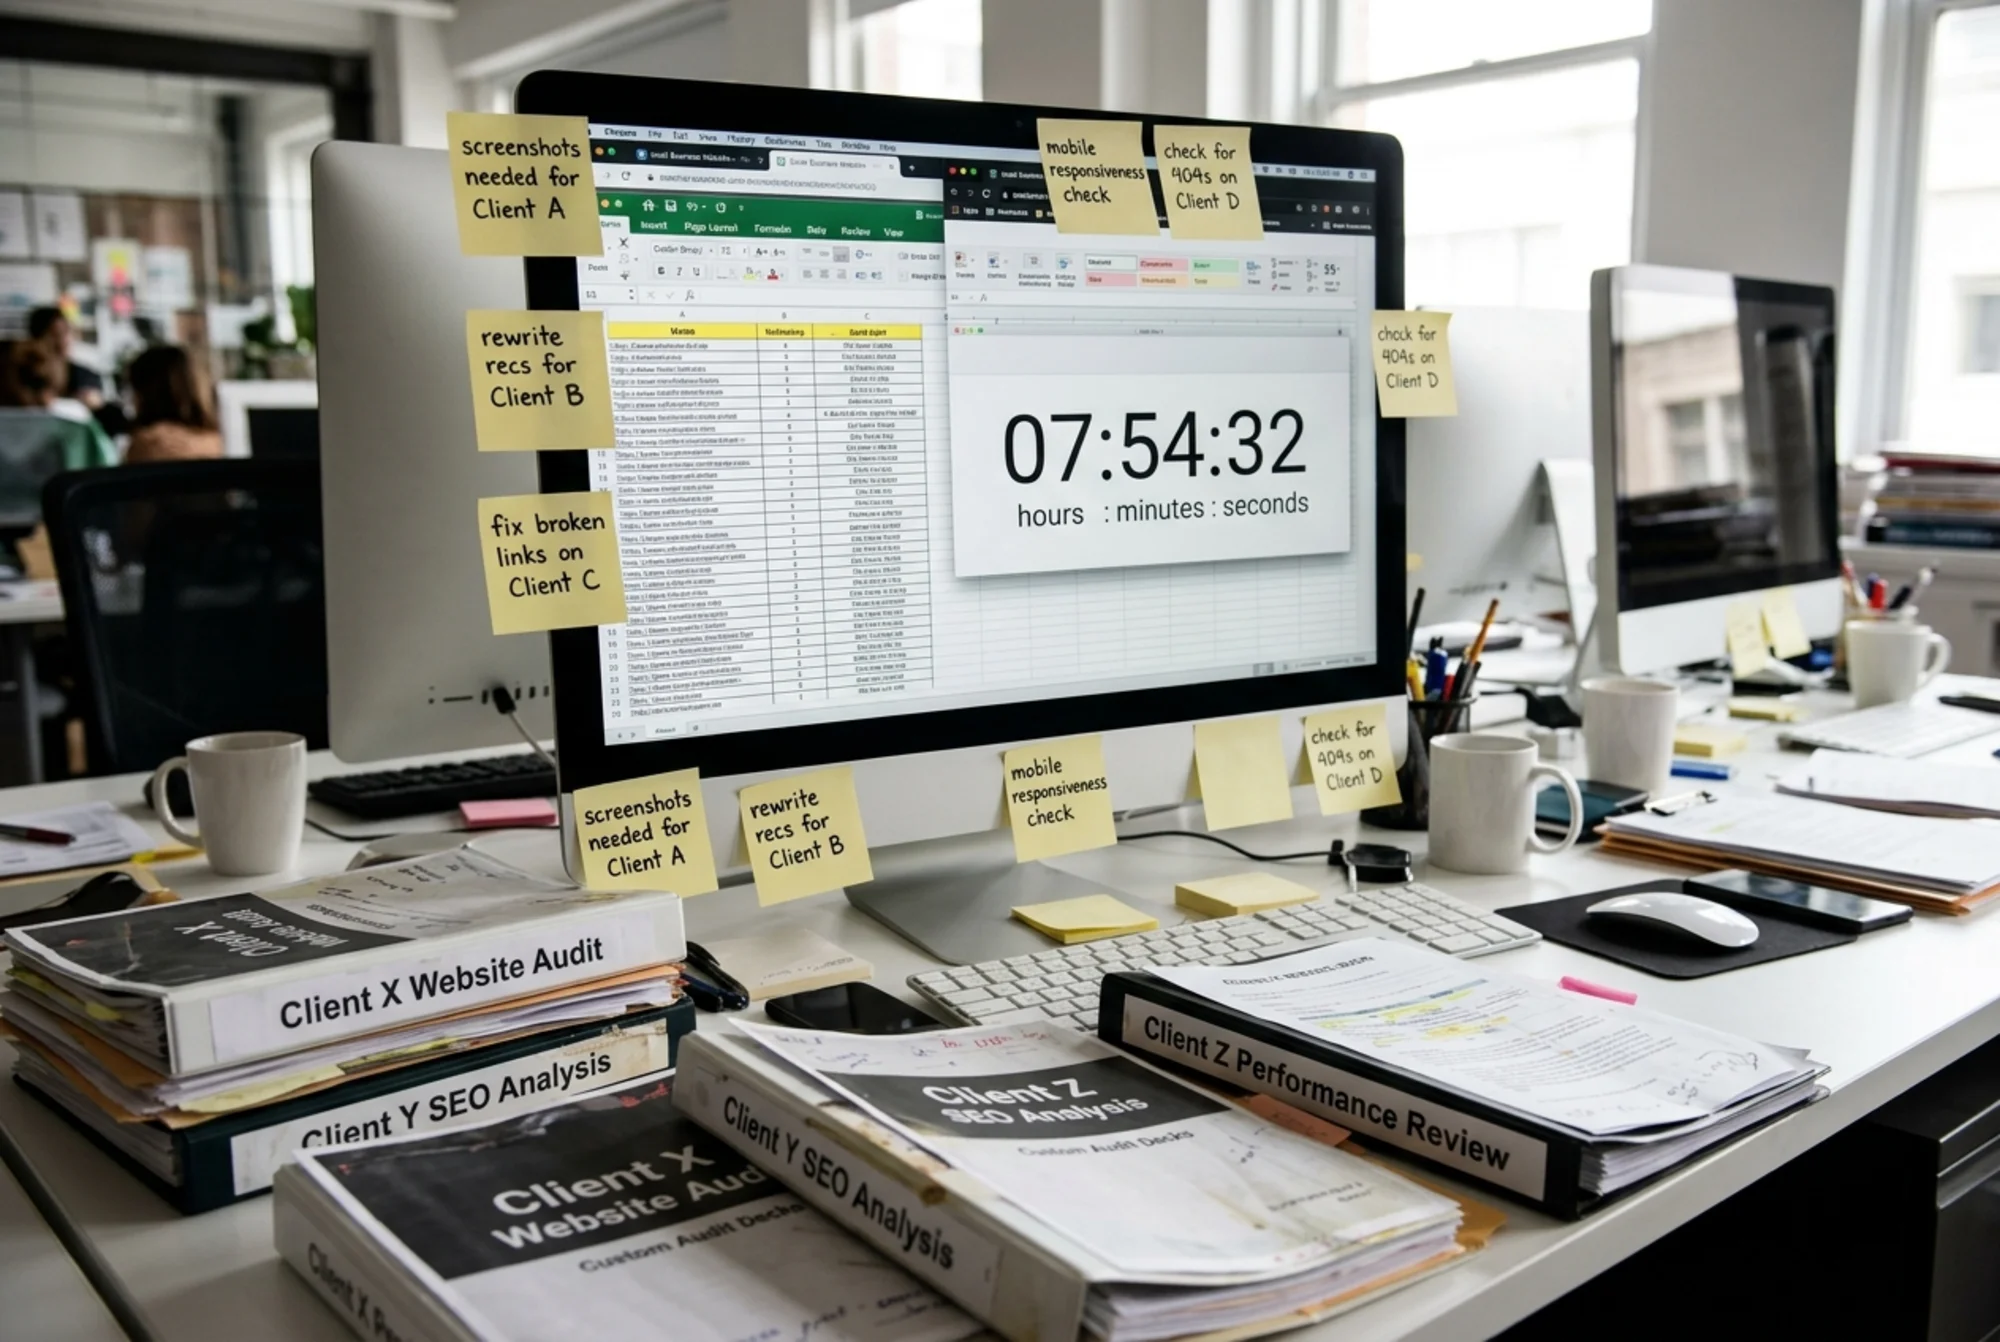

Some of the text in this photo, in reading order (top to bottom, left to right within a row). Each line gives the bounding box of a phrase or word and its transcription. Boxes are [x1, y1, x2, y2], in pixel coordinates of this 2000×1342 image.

[462, 138, 581, 158] screenshots
[1046, 138, 1097, 156] mobile
[1164, 142, 1236, 159] check for
[465, 165, 580, 186] needed for
[1049, 164, 1145, 182] responsiveness
[1171, 167, 1238, 184] 404s on
[1063, 185, 1112, 203] check
[1176, 192, 1240, 210] Client D
[473, 196, 566, 219] Client A
[481, 325, 564, 346] rewrite
[486, 353, 577, 375] recs for
[1420, 353, 1435, 364] on
[1386, 371, 1439, 389] Client D
[490, 383, 584, 408] Client B
[1004, 409, 1307, 484] 07:54:32
[1018, 503, 1084, 527] hours
[1117, 499, 1205, 522] minutes
[1222, 491, 1309, 516] seconds
[491, 511, 606, 537] fix broken
[497, 544, 584, 567] links on
[509, 569, 601, 598] Client C
[1311, 724, 1350, 744] check
[1358, 749, 1375, 760] on
[1011, 756, 1062, 780] mobile
[1370, 766, 1383, 784] D
[750, 789, 819, 818] rewrite
[1012, 777, 1107, 805] responsiveness
[584, 789, 692, 825] screenshots
[588, 817, 690, 851] needed for
[755, 813, 829, 843] recs for
[607, 845, 686, 877] Client A
[769, 835, 845, 869] Client B
[280, 937, 604, 1029] Client X Website Audit
[399, 1101, 420, 1129] Y
[429, 1083, 490, 1122] SEO
[498, 1052, 612, 1103] Analysis
[922, 1077, 1098, 1105] Client Z
[1144, 1016, 1208, 1060] Client
[1213, 1040, 1231, 1068] Z
[1236, 1048, 1398, 1130] Performance
[1406, 1109, 1510, 1171] Review
[940, 1098, 1150, 1125] SEO Analysis
[493, 1145, 715, 1215] Client X
[724, 1096, 955, 1271] Client Y SEO Analysis
[491, 1194, 678, 1249] Website
[676, 1220, 738, 1249] Audit
